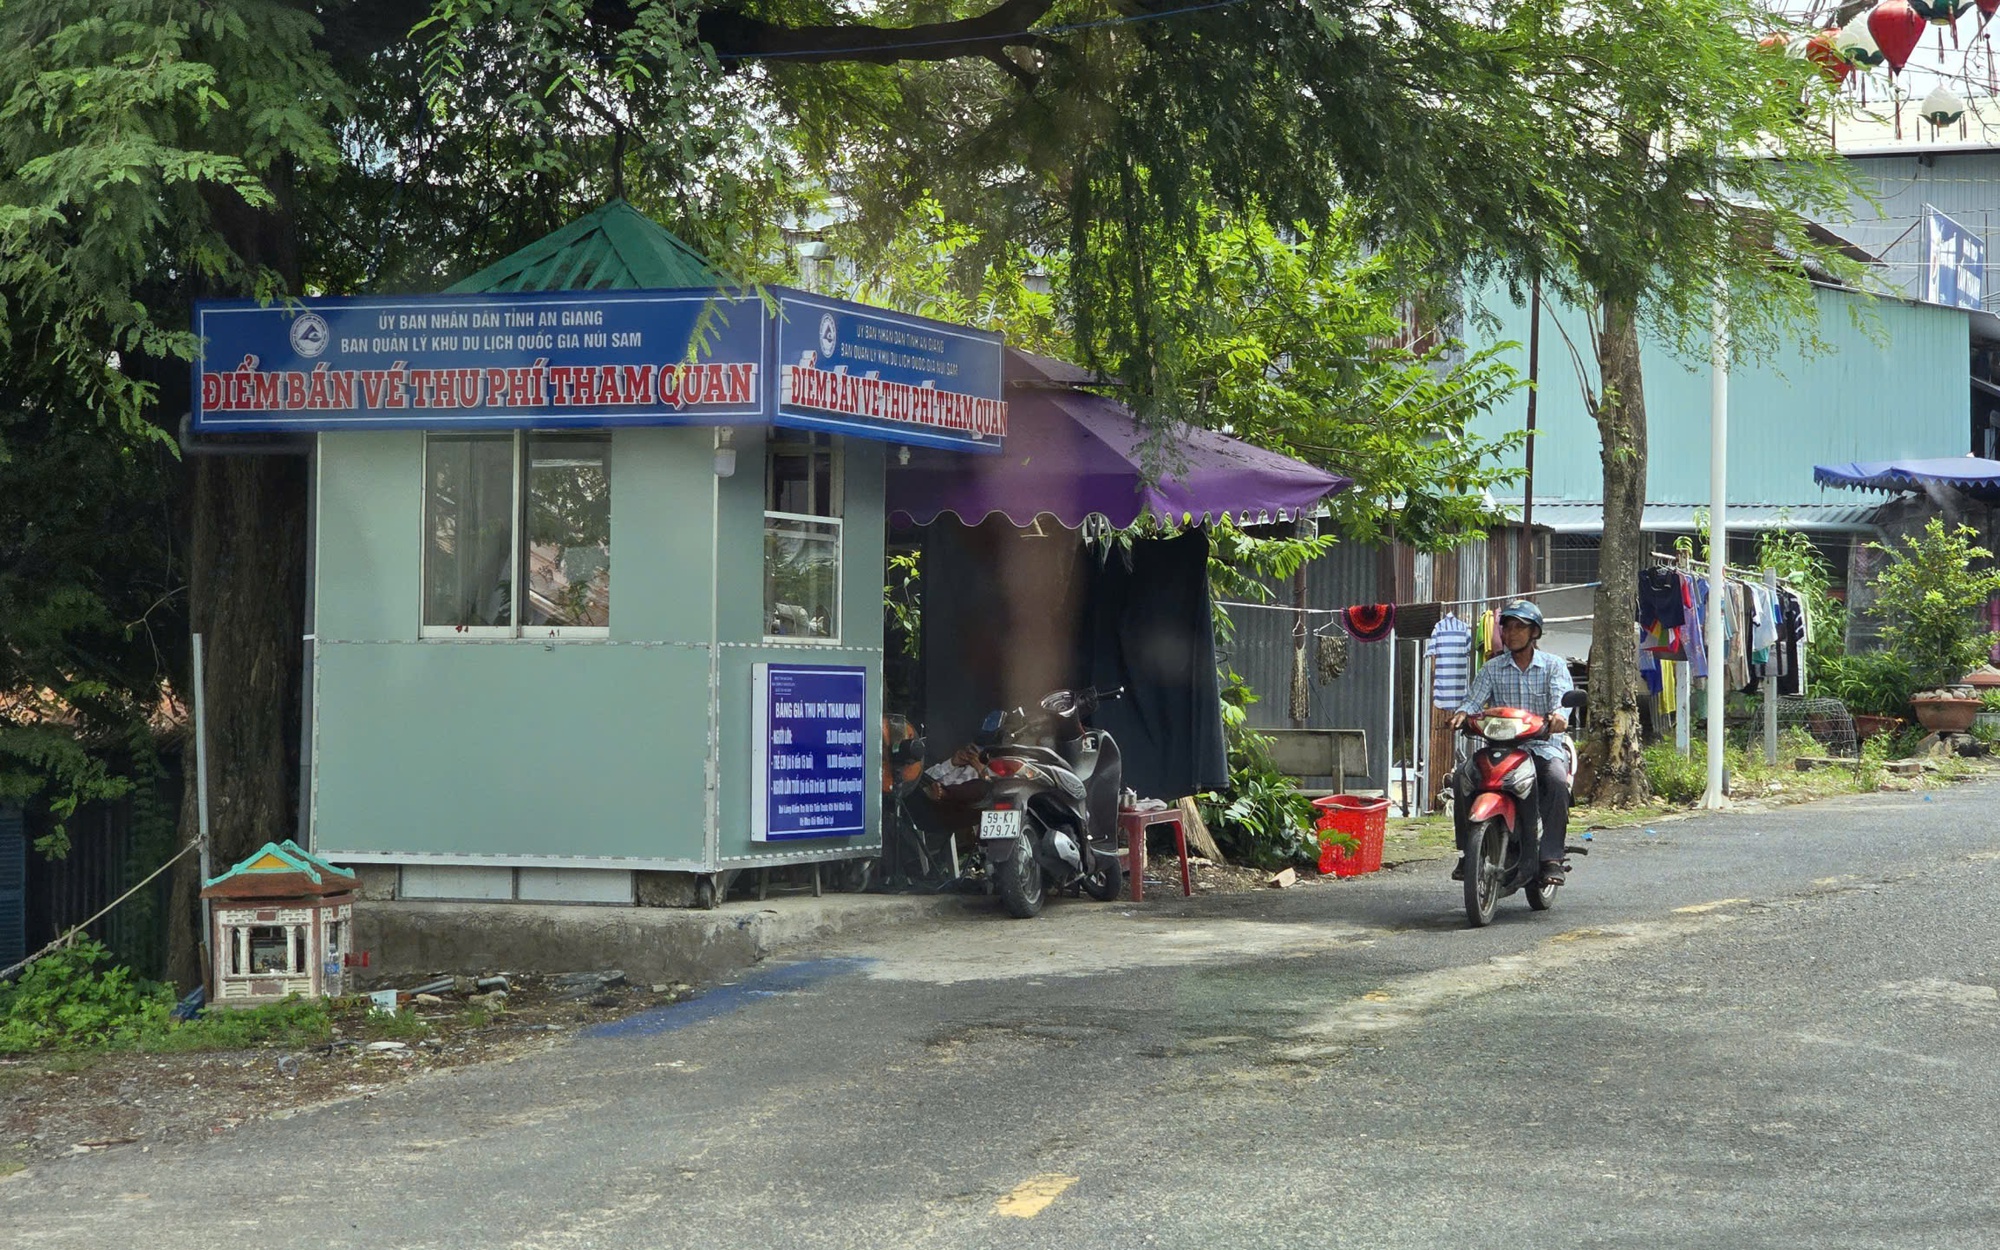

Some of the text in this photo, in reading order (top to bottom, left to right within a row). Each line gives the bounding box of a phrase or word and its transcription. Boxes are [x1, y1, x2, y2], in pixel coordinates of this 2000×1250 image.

[400, 314, 427, 329] BAN
[431, 311, 468, 329] NHÂN
[473, 310, 500, 328] DÂN
[538, 312, 557, 326] AN
[562, 311, 603, 326] GIANG
[341, 329, 641, 354] BAN QUẢN LÝ KHU DU LỊCH QUỐC GIA NÚI SAM
[202, 354, 756, 412] ĐIỂM BÁN VÉ THU PHÍ THAM QUAN
[788, 350, 1008, 438] ĐIỂM BÁN VÉ THU PHÍ THAM QUAN
[775, 697, 793, 719] BẢNG
[804, 702, 816, 718] THU
[817, 699, 828, 718] PHÍ
[828, 702, 844, 718] THAM
[845, 703, 861, 720] QUAN
[983, 824, 1016, 837] 979.74
